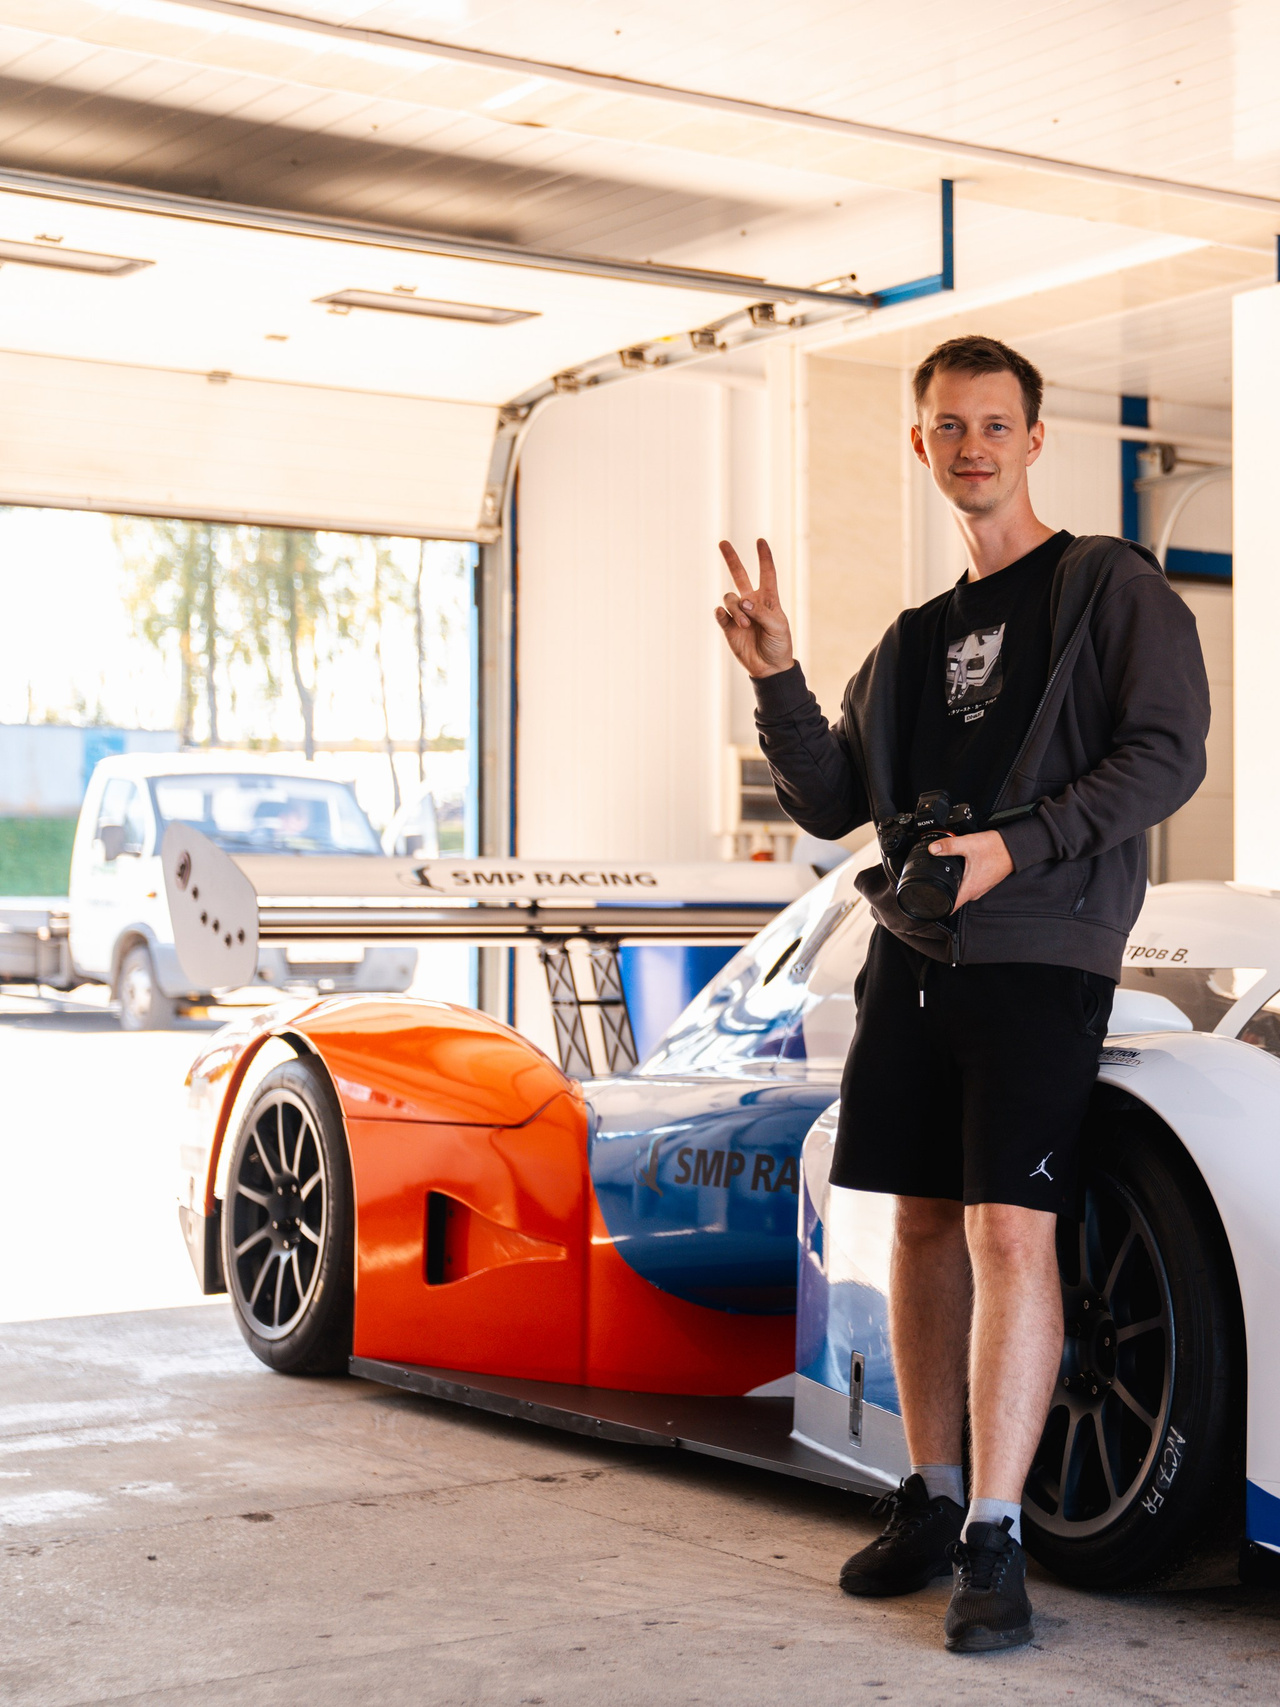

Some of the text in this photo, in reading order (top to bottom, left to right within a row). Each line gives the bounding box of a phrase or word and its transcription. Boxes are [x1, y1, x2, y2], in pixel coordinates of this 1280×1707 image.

[451, 871, 658, 888] SMP RACING
[1126, 945, 1169, 960] тров
[674, 1147, 799, 1195] SMP RA
